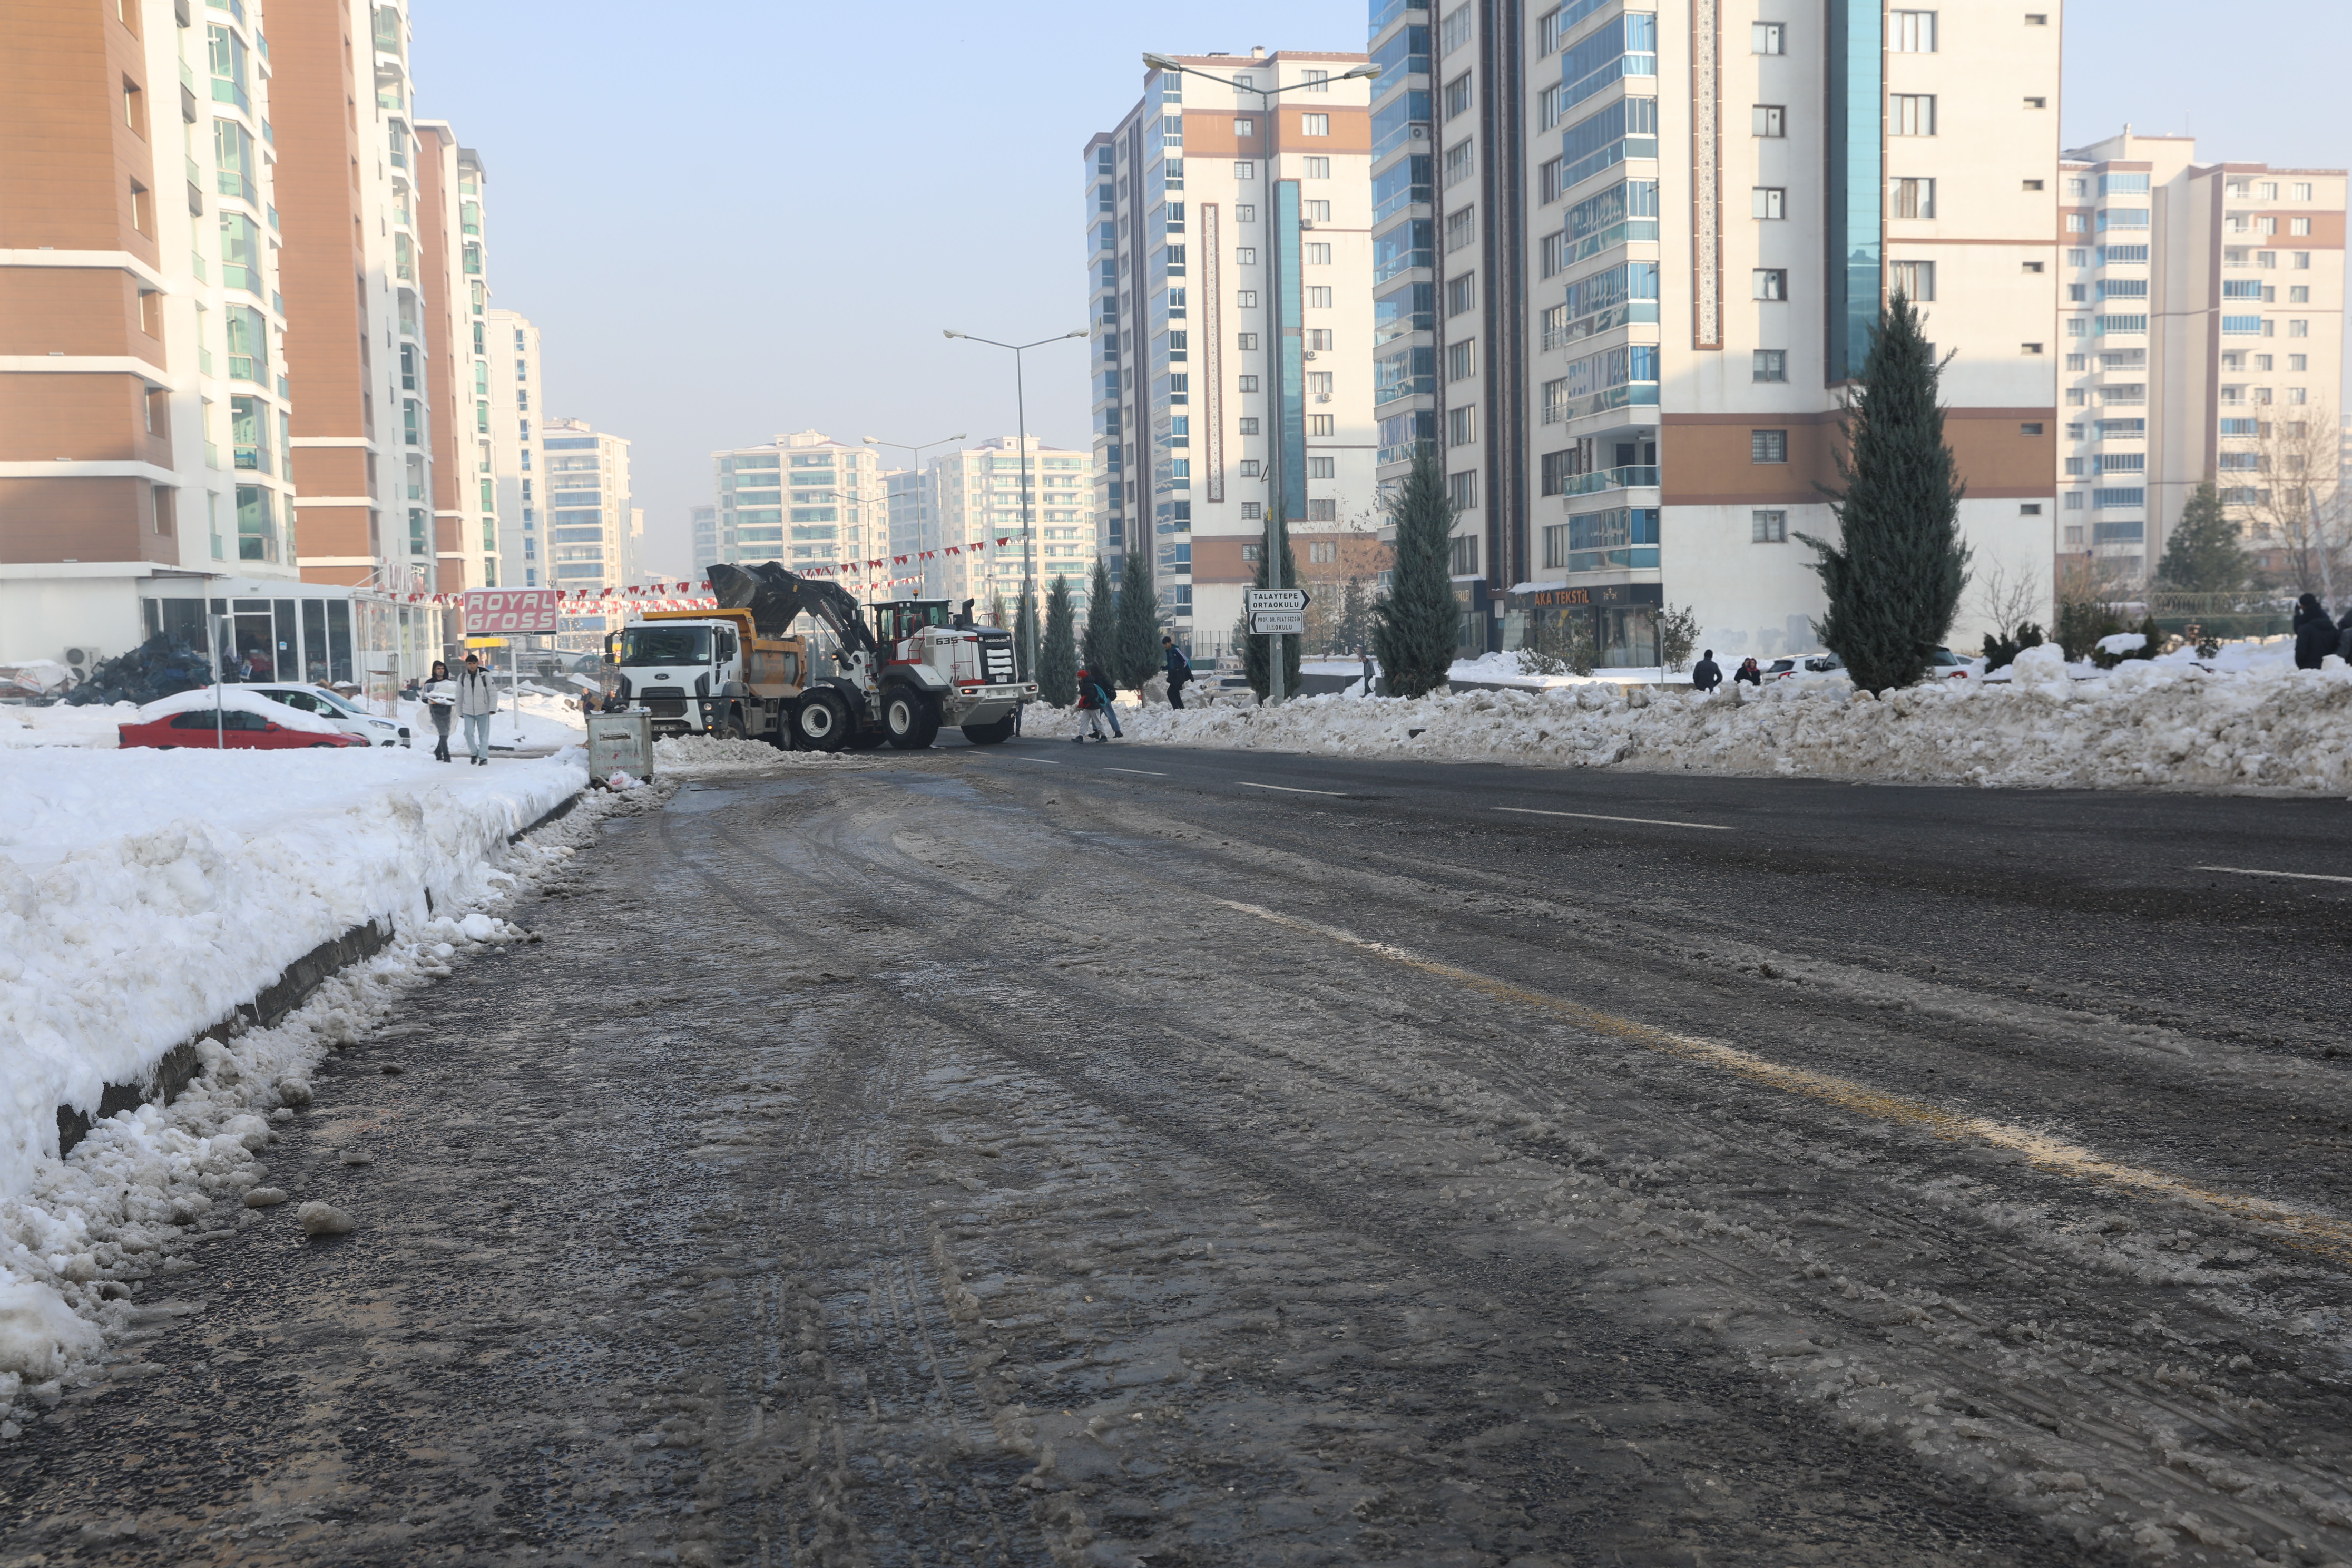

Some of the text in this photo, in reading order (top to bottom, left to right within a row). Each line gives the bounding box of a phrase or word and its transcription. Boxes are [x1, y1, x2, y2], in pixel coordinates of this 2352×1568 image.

[467, 593, 553, 611] ROYAL
[1534, 593, 1552, 606] AKA
[467, 612, 554, 630] GROSS
[936, 636, 958, 645] 635
